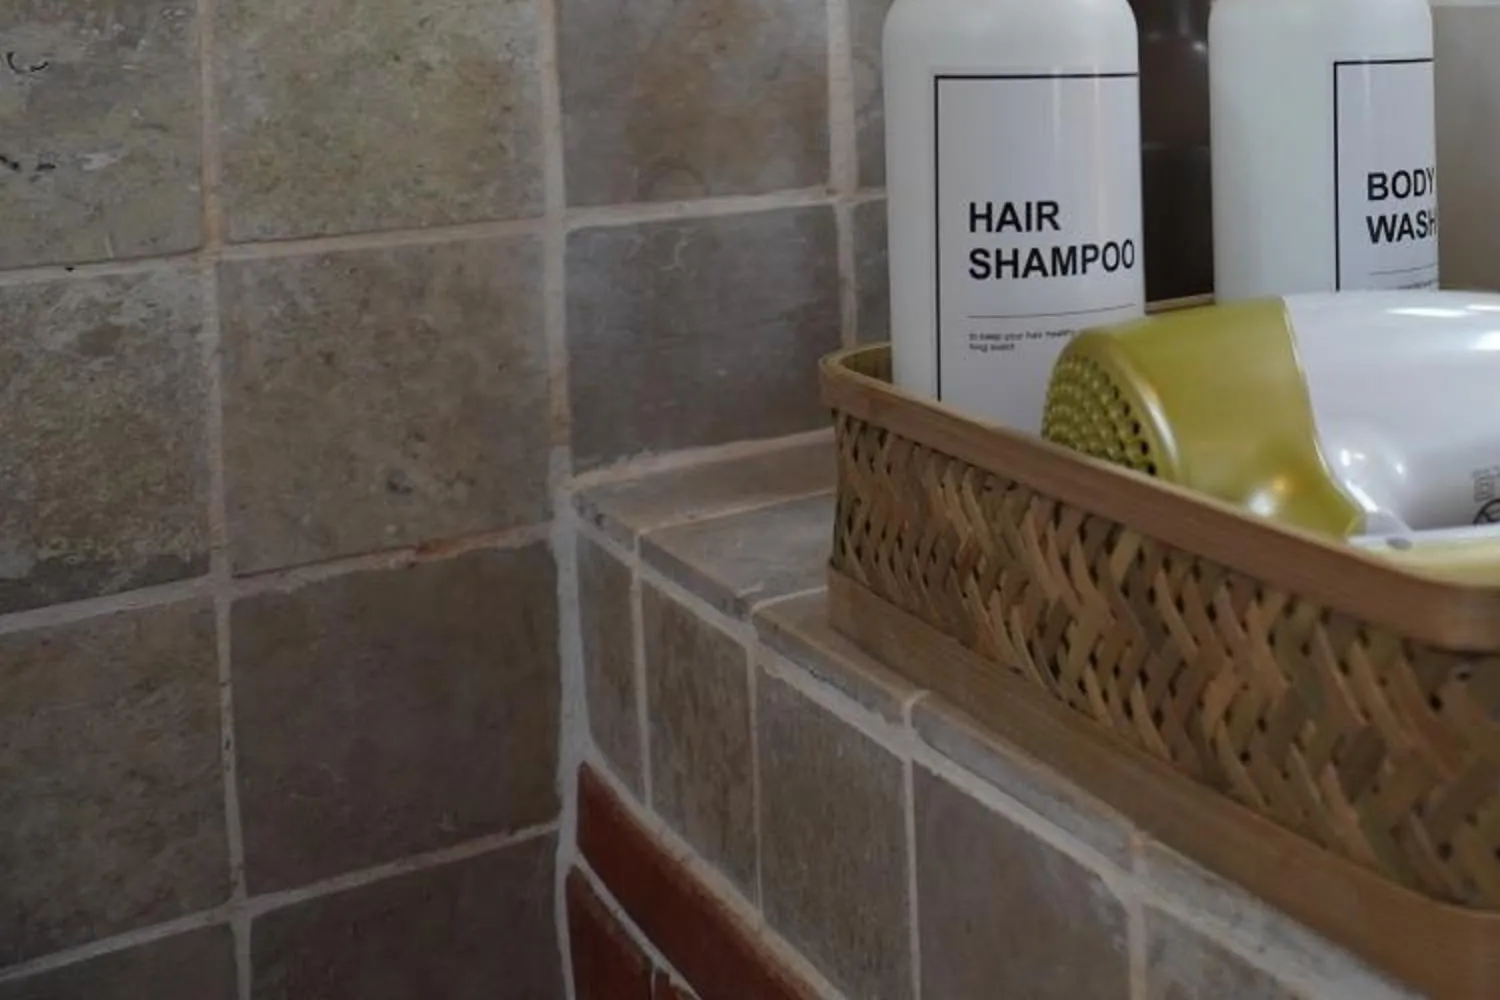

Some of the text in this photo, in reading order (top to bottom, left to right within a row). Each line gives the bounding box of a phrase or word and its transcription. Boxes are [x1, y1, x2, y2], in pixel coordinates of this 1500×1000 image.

[1367, 167, 1435, 201] BODY
[969, 200, 1061, 233] HAIR
[1365, 209, 1437, 244] WASH
[968, 238, 1135, 280] SHAMPOO
